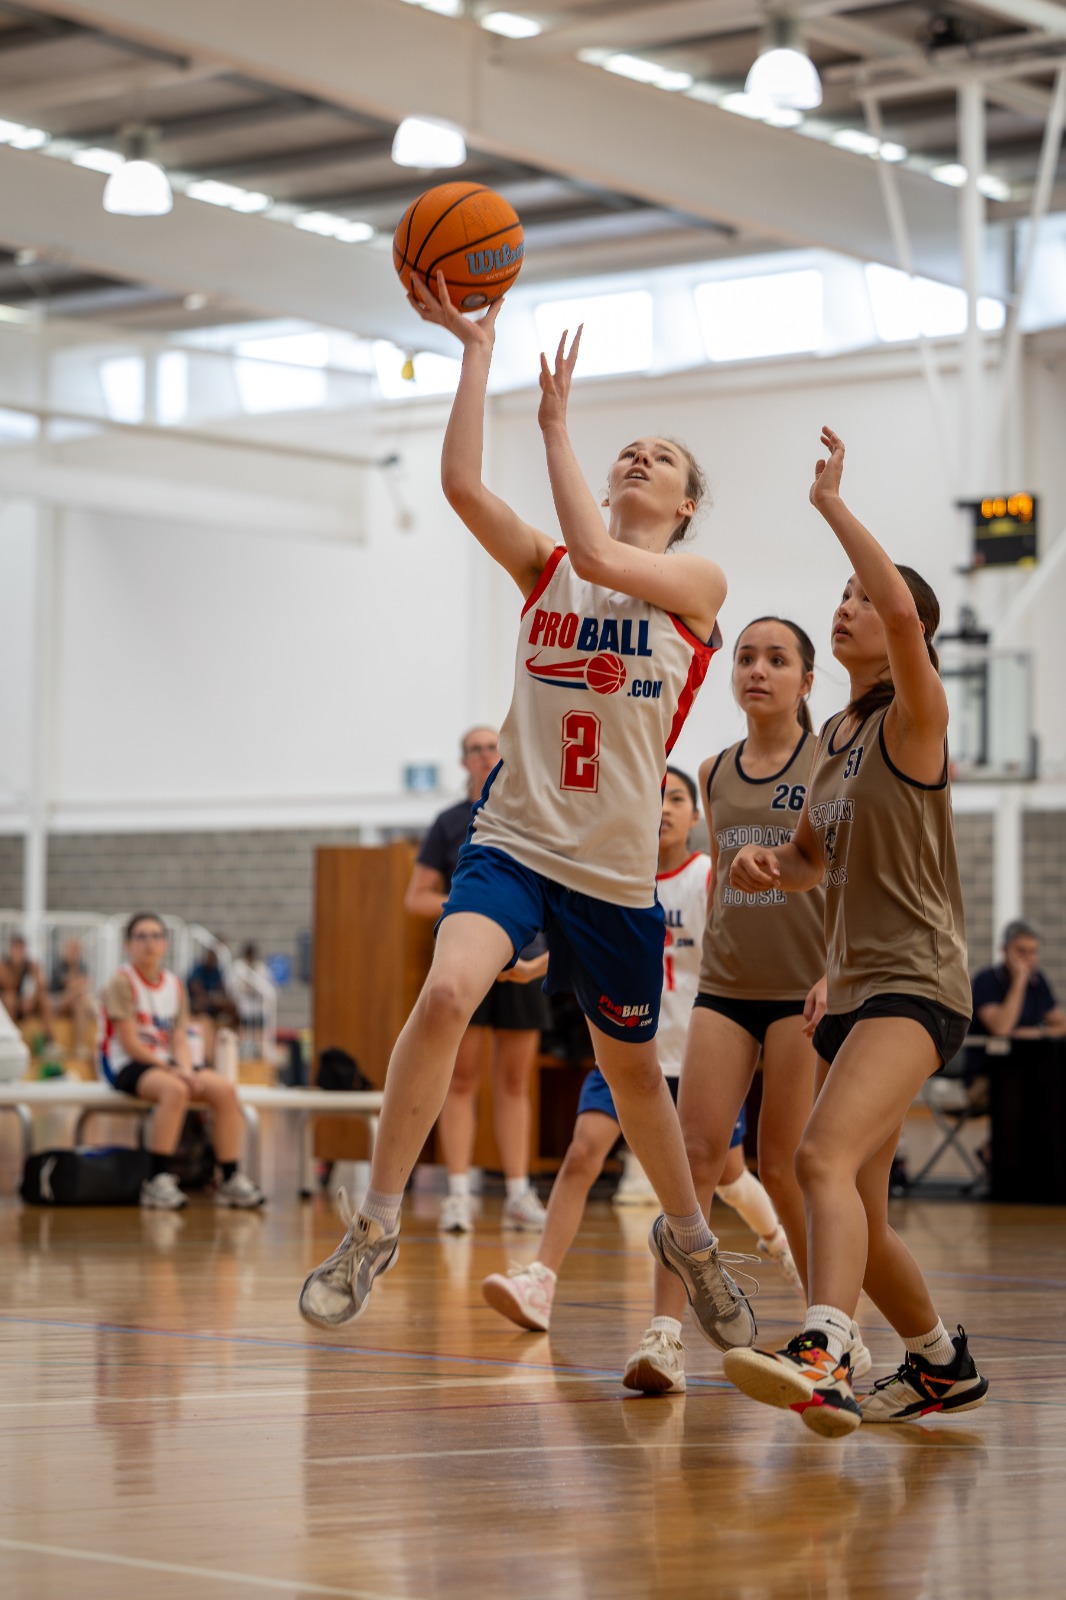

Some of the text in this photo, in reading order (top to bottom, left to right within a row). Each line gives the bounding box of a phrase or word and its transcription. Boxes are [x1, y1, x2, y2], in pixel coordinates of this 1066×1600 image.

[466, 242, 525, 275] Wilso
[528, 608, 653, 657] PROBALL
[560, 709, 601, 794] 2
[843, 746, 864, 779] 51
[771, 784, 806, 811] 26
[808, 798, 855, 830] EDDAM
[723, 887, 786, 905] HOUSE
